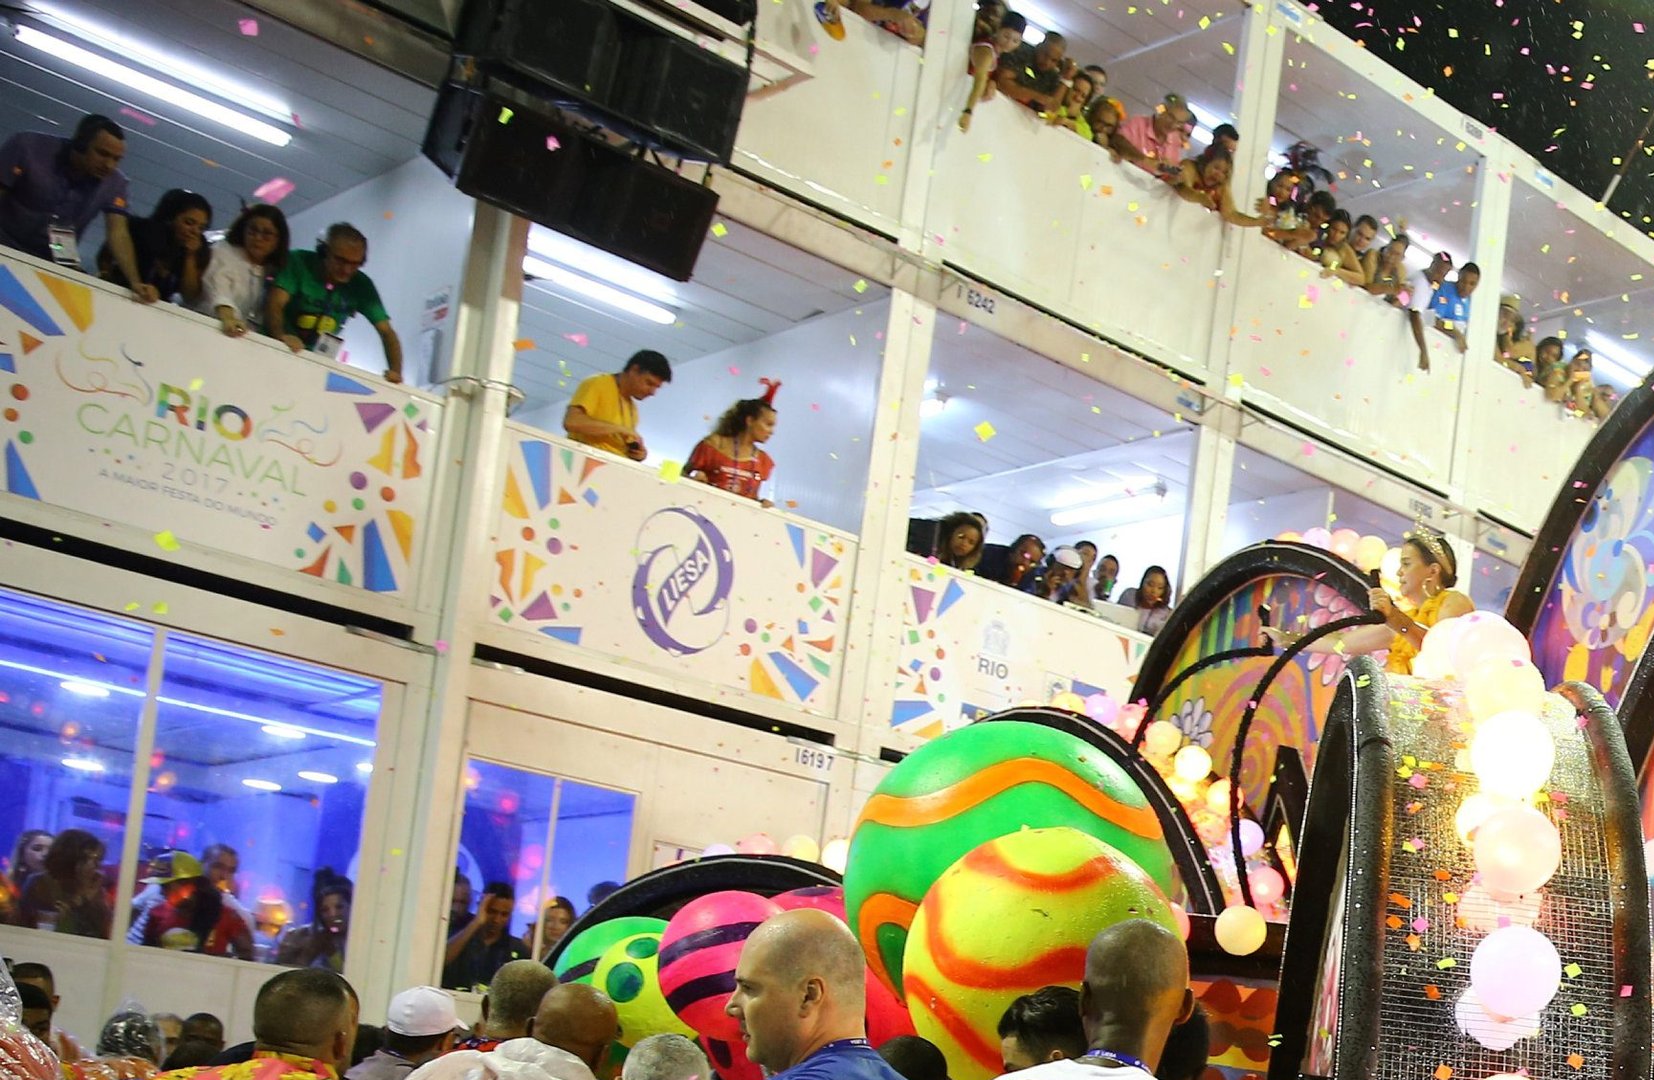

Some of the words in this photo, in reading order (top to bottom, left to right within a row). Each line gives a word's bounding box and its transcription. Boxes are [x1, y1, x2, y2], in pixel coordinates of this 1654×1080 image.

[156, 382, 253, 441] RIO
[77, 403, 306, 496] CARNAVAL
[162, 462, 230, 493] 2017
[113, 471, 159, 491] MAIOR
[161, 486, 200, 503] FESTA
[204, 497, 225, 511] DO
[227, 504, 277, 526] MUNDO
[661, 550, 709, 611] LIESA
[977, 657, 1009, 680] RIO
